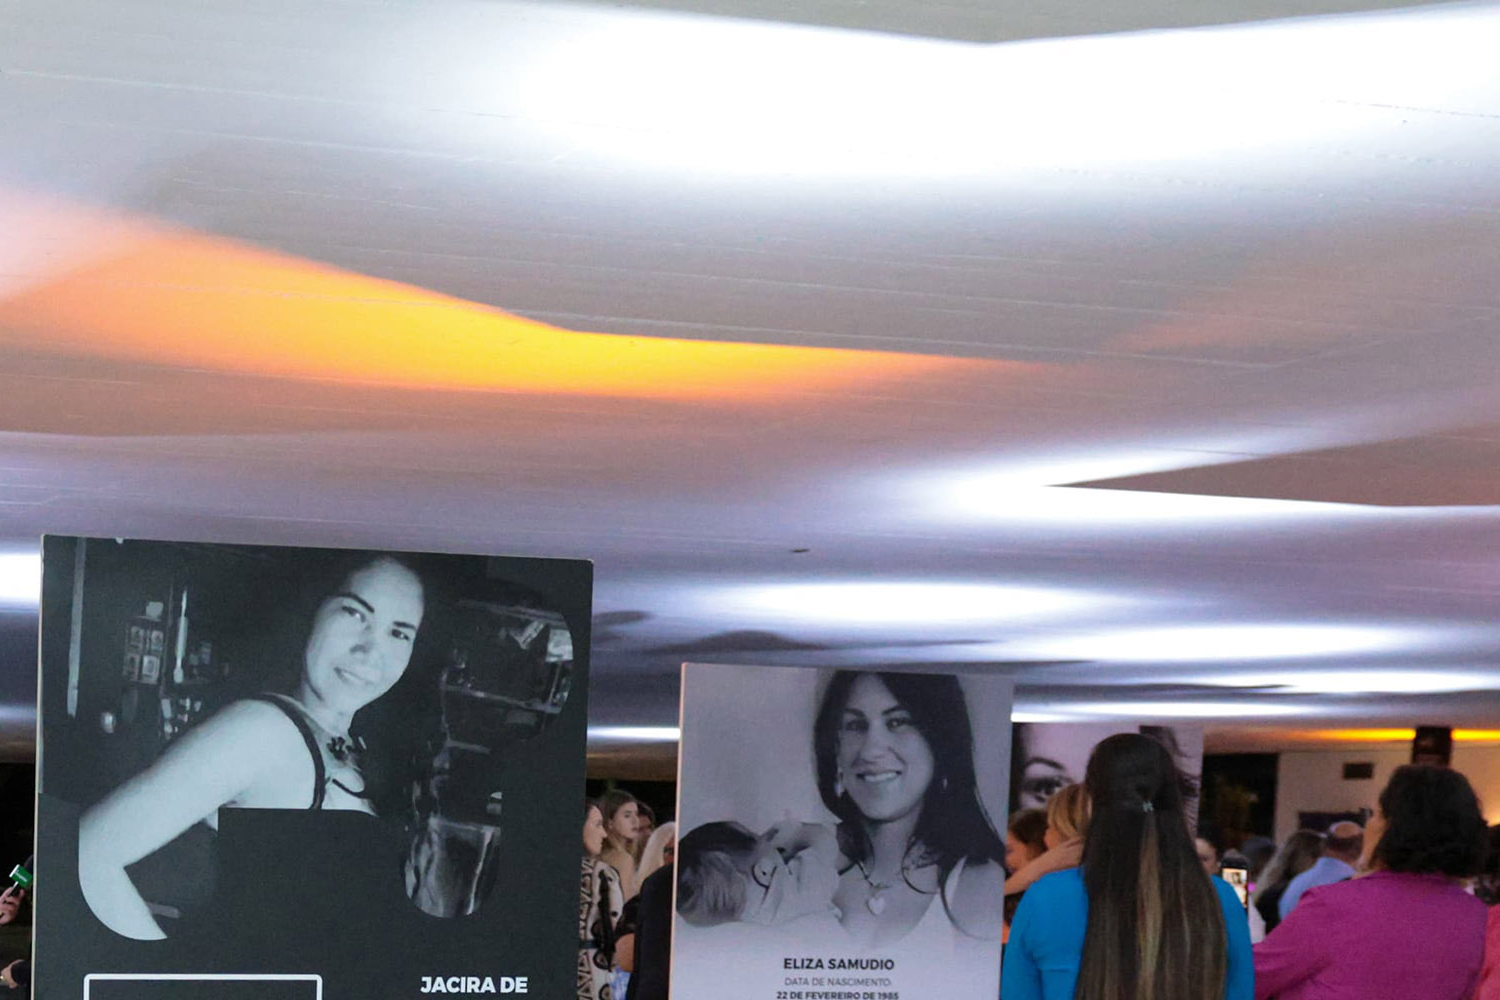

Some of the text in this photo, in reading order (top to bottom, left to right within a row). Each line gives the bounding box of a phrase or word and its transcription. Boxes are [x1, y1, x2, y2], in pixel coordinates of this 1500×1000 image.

[784, 958, 895, 970] ELIZA SAMUDIO
[420, 976, 528, 993] JACIRA DE
[784, 977, 809, 986] DATA
[812, 977, 825, 986] DE
[790, 992, 803, 1000] DE
[806, 992, 861, 1000] FEVEREIRO
[863, 992, 875, 1000] DE
